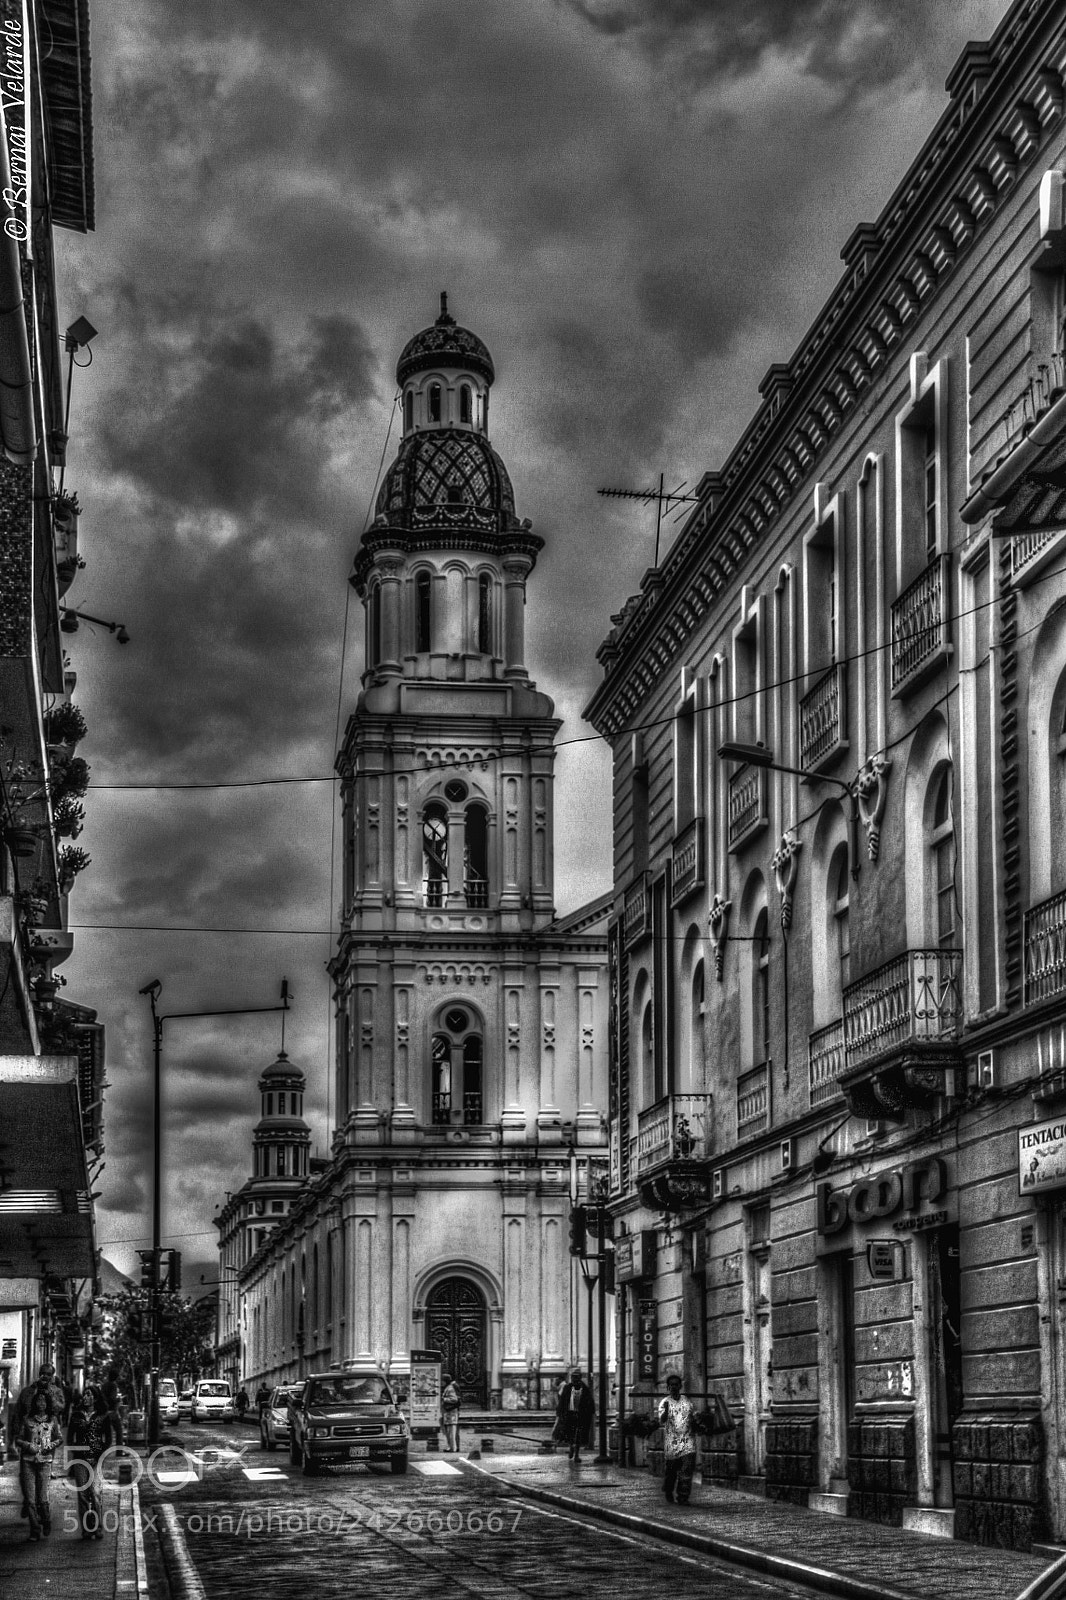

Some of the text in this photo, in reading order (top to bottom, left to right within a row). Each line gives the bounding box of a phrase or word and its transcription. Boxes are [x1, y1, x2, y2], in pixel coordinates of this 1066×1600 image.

[1020, 1123, 1066, 1149] TENTACI
[817, 1158, 948, 1235] boon
[874, 1258, 893, 1266] VISA
[643, 1322, 653, 1374] FOTOS
